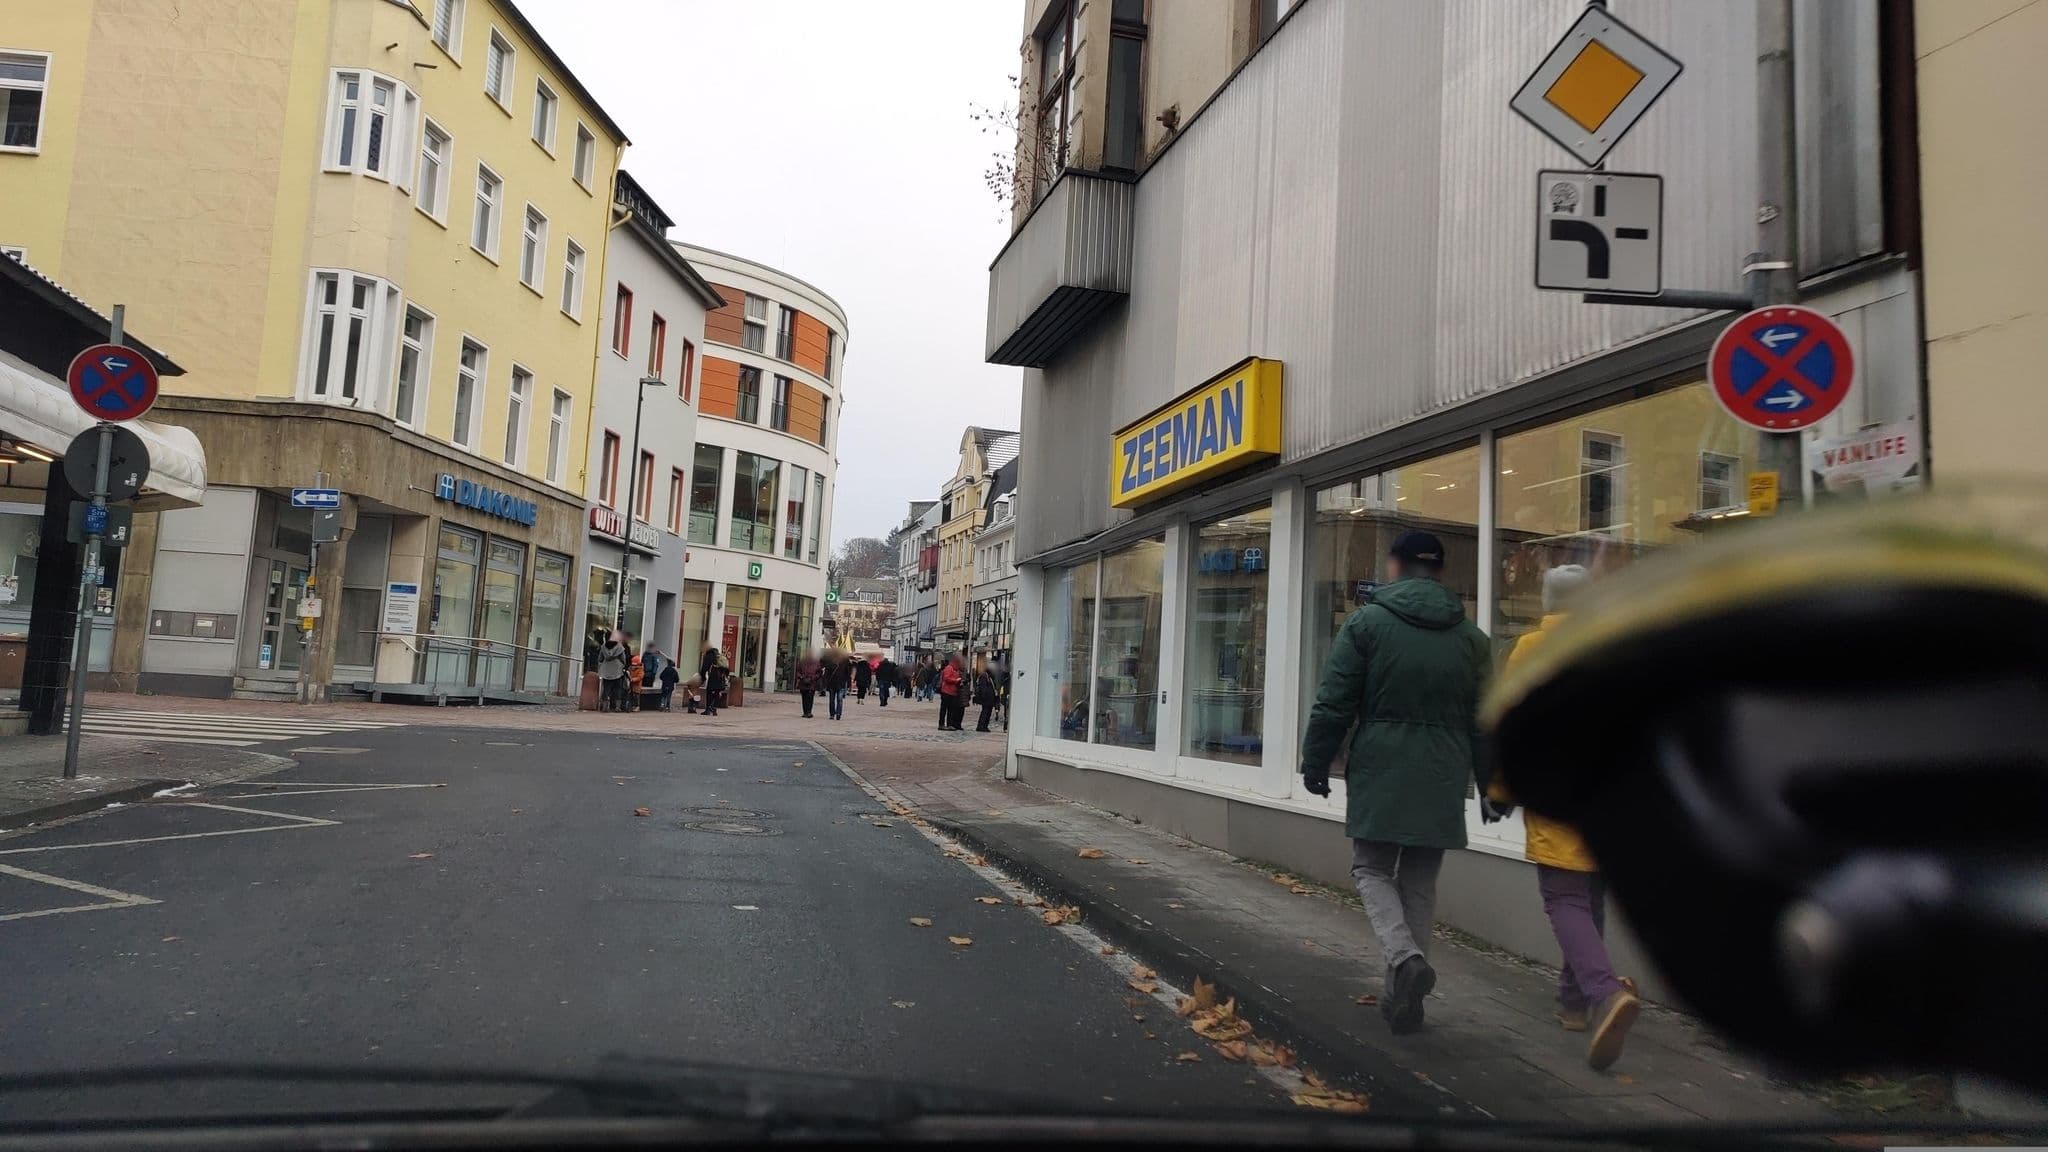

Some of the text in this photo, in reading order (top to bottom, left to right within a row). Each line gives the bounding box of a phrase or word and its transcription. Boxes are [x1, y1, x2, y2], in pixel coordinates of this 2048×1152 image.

[1121, 379, 1243, 494] ZEEMAN
[1824, 436, 1905, 467] VANLIFE
[459, 480, 537, 527] DIAKONIE
[751, 564, 761, 576] D
